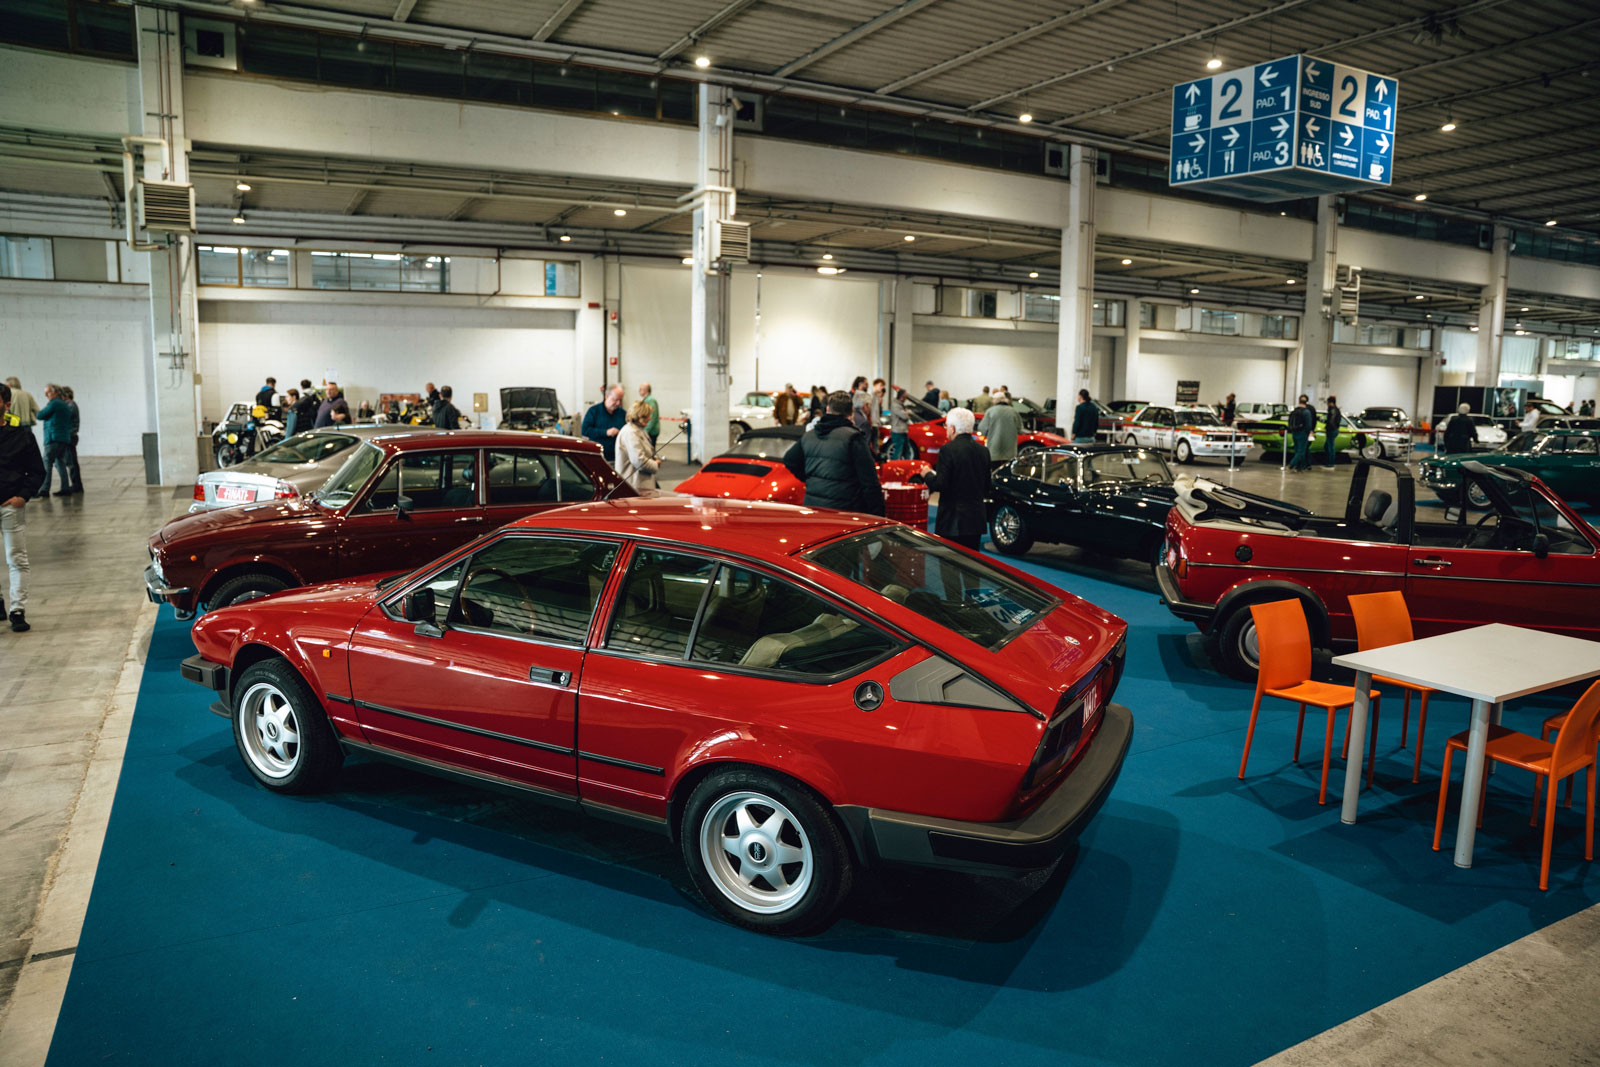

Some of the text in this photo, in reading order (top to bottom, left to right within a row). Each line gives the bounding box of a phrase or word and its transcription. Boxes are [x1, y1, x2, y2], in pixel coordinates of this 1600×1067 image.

[1219, 78, 1243, 121] 2
[1256, 86, 1291, 111] PAD. 1
[1302, 87, 1330, 102] INGRESSO
[1309, 99, 1322, 110] SUD
[1339, 75, 1358, 118] 2
[1366, 106, 1391, 130] PAD. 1
[1253, 141, 1289, 165] PAD. 3
